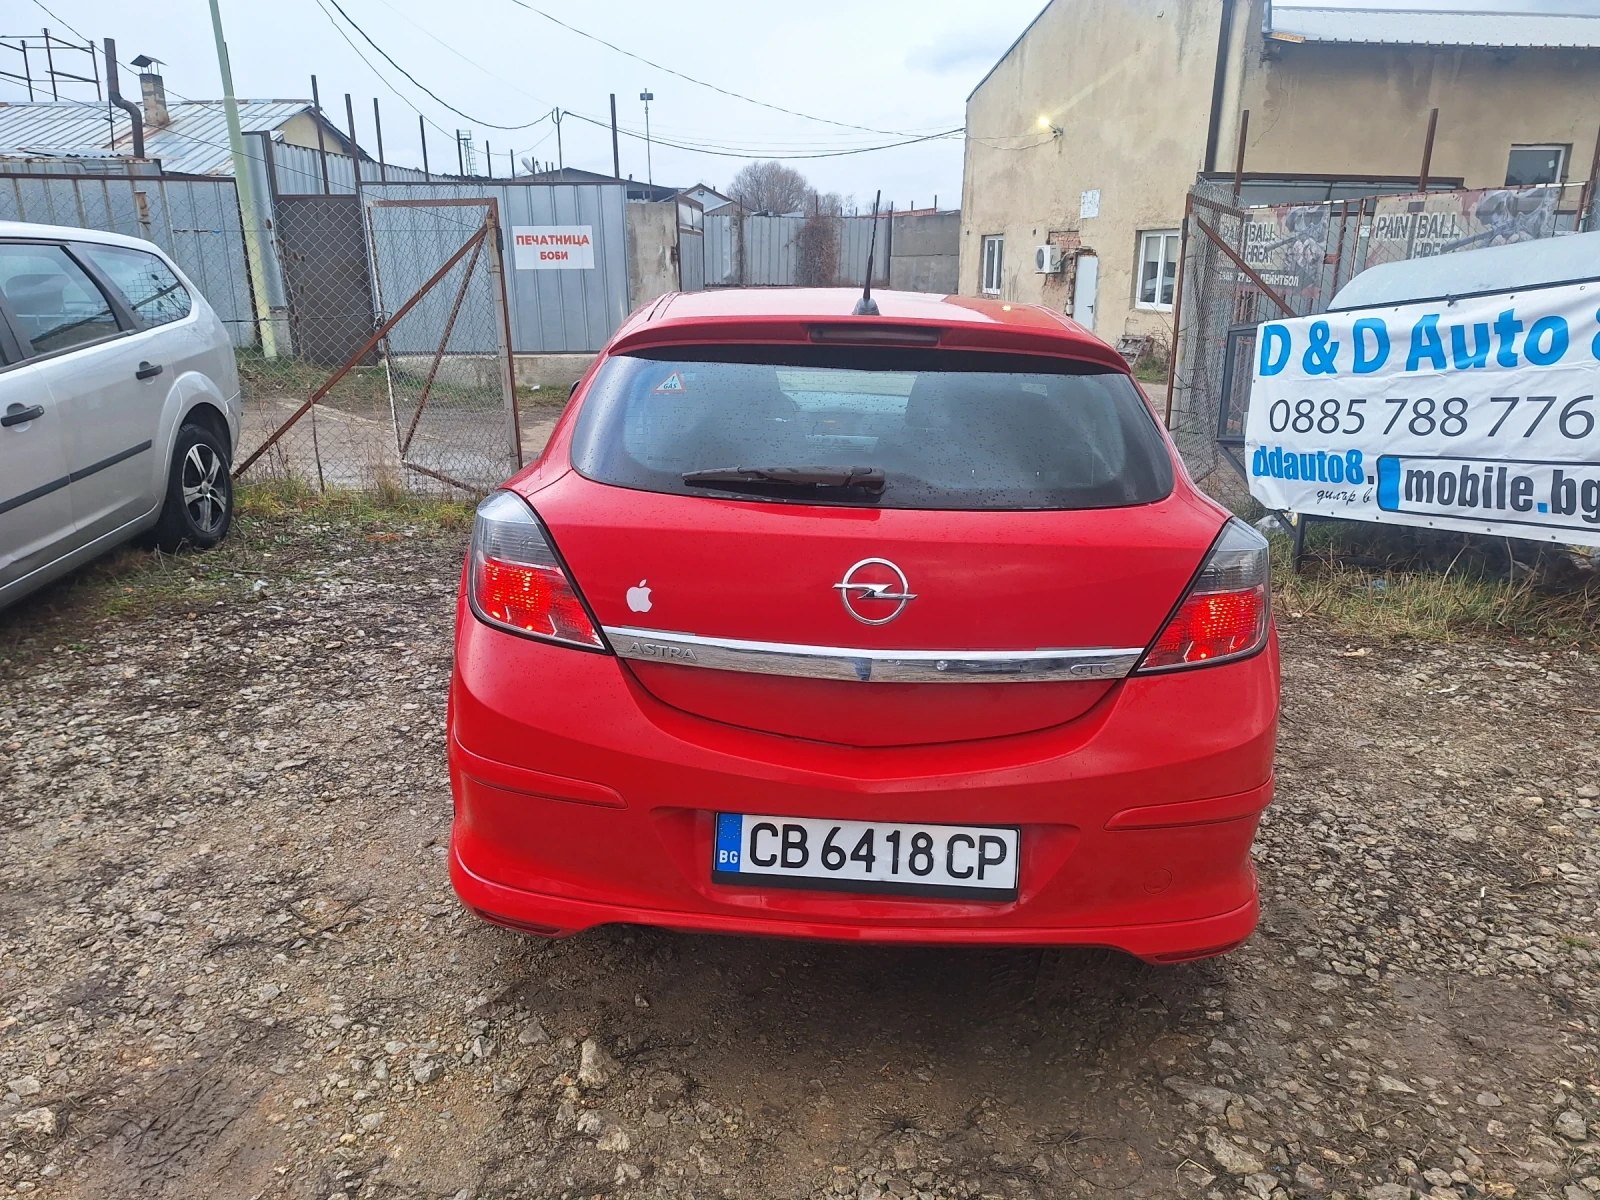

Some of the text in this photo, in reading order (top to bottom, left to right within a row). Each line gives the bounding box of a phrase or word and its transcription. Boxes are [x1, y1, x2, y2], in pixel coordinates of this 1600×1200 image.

[1416, 213, 1461, 239] BALL
[515, 234, 590, 246] ПЕЧАТНИЦА
[539, 251, 569, 260] БОБИ
[1259, 324, 1292, 376] D
[1302, 320, 1340, 375] &
[1352, 318, 1391, 374] D
[1405, 308, 1569, 372] Auto
[1269, 395, 1595, 440] 0885 788 776
[1404, 465, 1600, 523] mobile.bg
[628, 642, 697, 660] ASTRA
[1070, 663, 1117, 676] GTC
[719, 822, 1008, 881] BG CB 6418 CP
